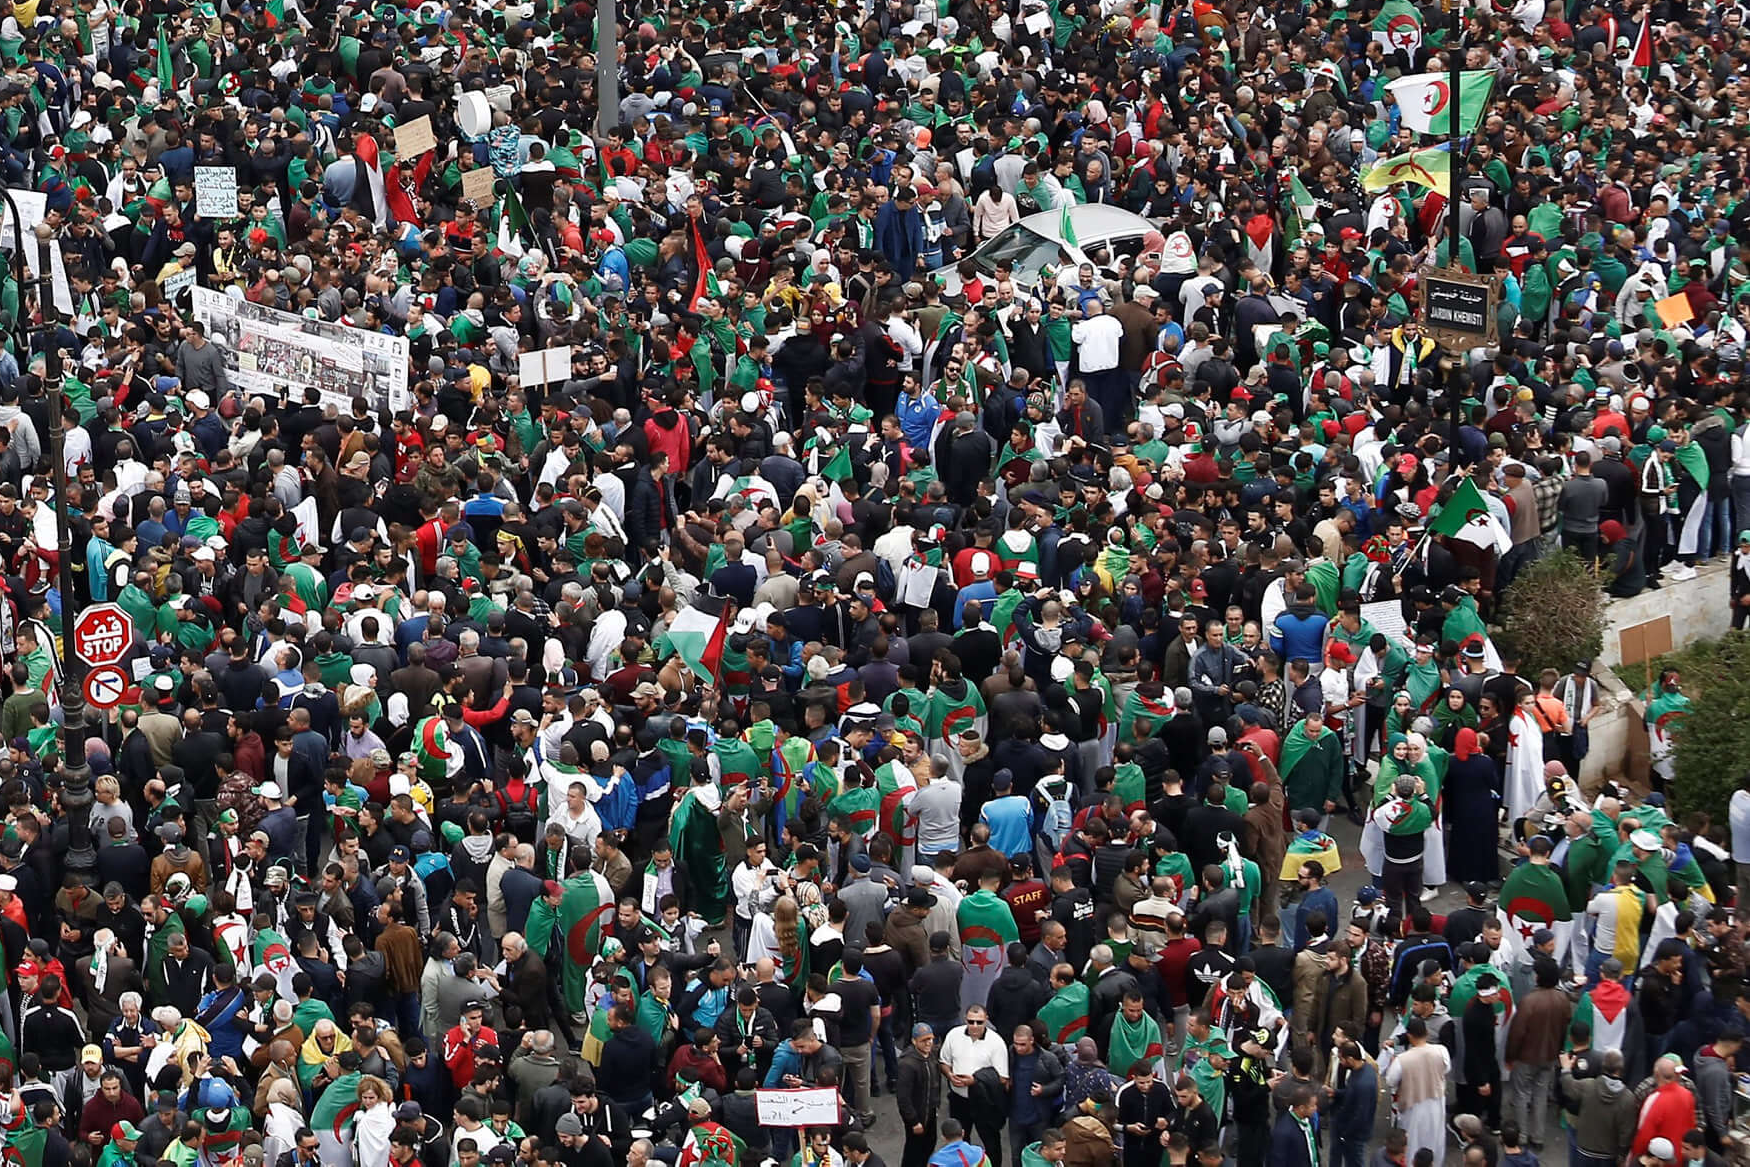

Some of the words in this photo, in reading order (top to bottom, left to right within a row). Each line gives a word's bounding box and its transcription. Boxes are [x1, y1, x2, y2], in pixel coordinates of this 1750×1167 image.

[1459, 290, 1483, 305] حديقة
[1430, 305, 1452, 322] JARDIN
[1453, 309, 1483, 326] KHEMISTI
[81, 615, 123, 641] قف
[83, 637, 123, 657] STOP
[1013, 889, 1043, 907] STAFF
